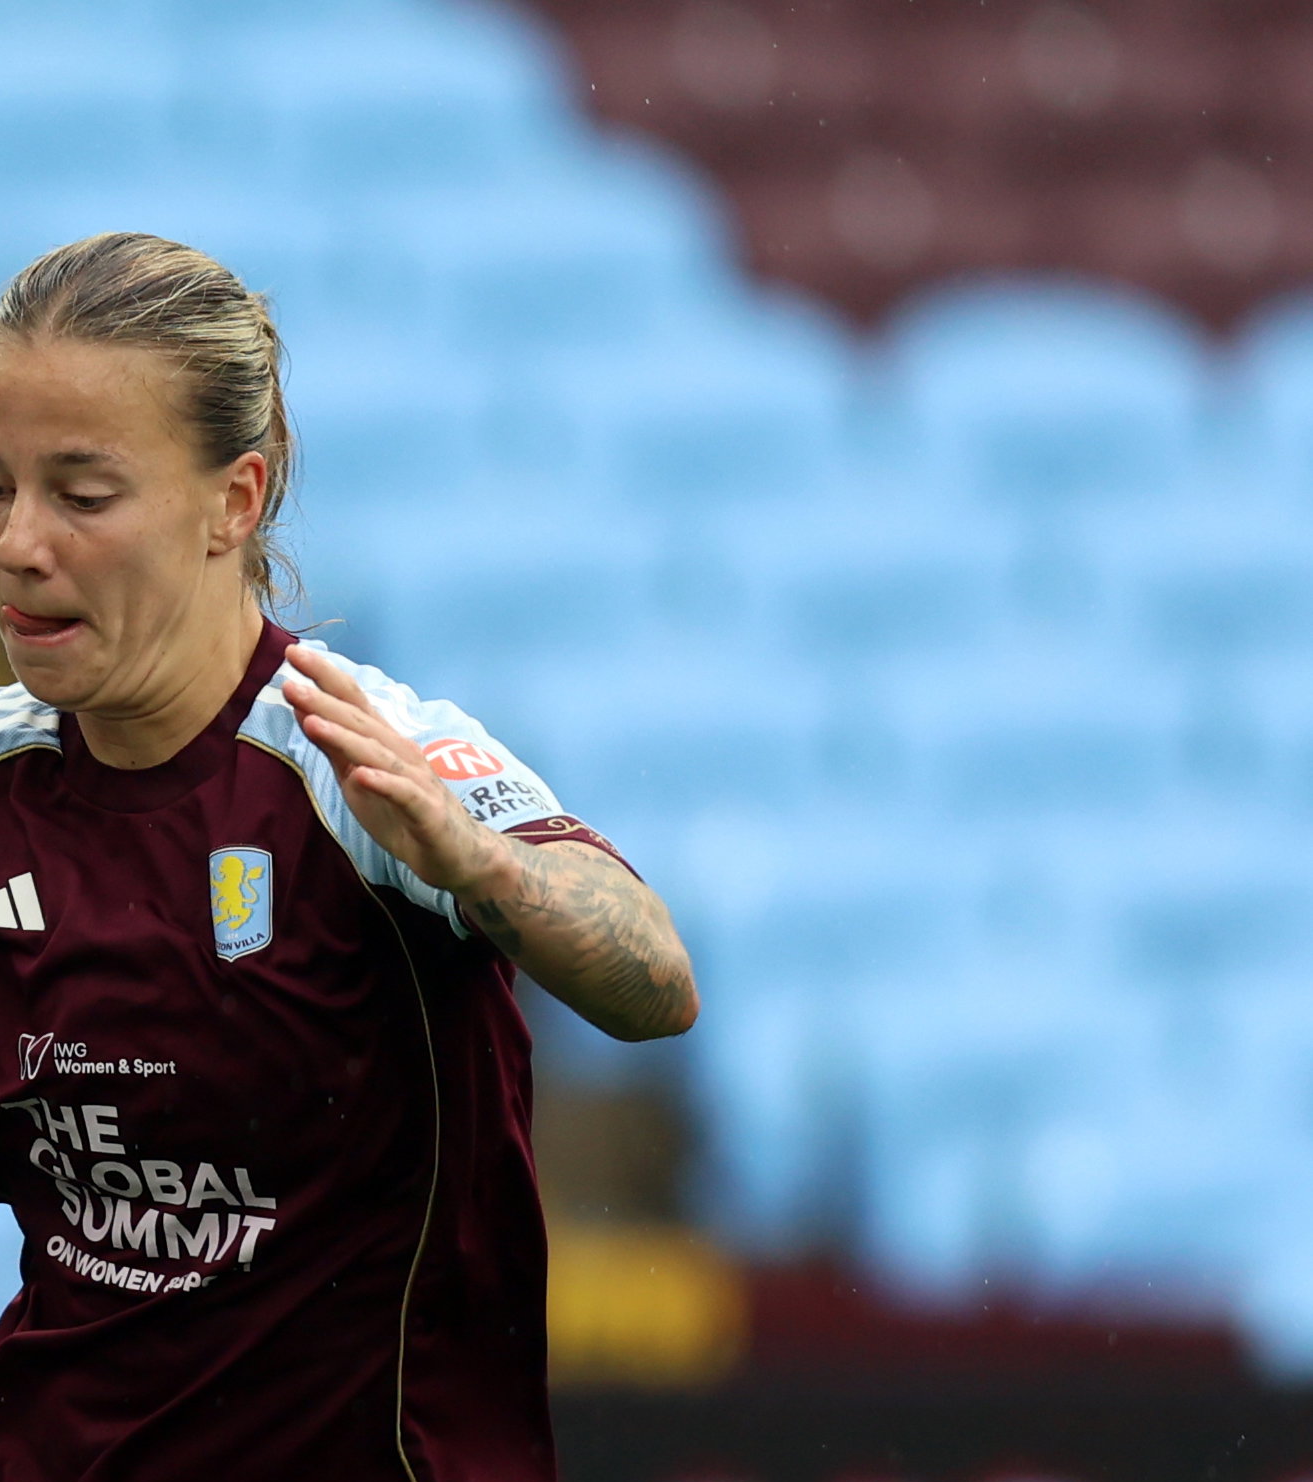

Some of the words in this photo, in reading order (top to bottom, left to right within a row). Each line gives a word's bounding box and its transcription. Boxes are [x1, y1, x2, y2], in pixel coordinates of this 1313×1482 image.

[234, 932, 265, 950] VILLA
[53, 1042, 87, 1058] IWG
[54, 1058, 115, 1074] Women
[118, 1058, 131, 1074] &
[133, 1058, 177, 1078] Sport
[0, 1097, 126, 1155] THE
[29, 1137, 277, 1210] GLOBAL
[54, 1178, 276, 1264] SUMMIT
[46, 1235, 76, 1267] ON
[74, 1249, 165, 1293] WOMEN
